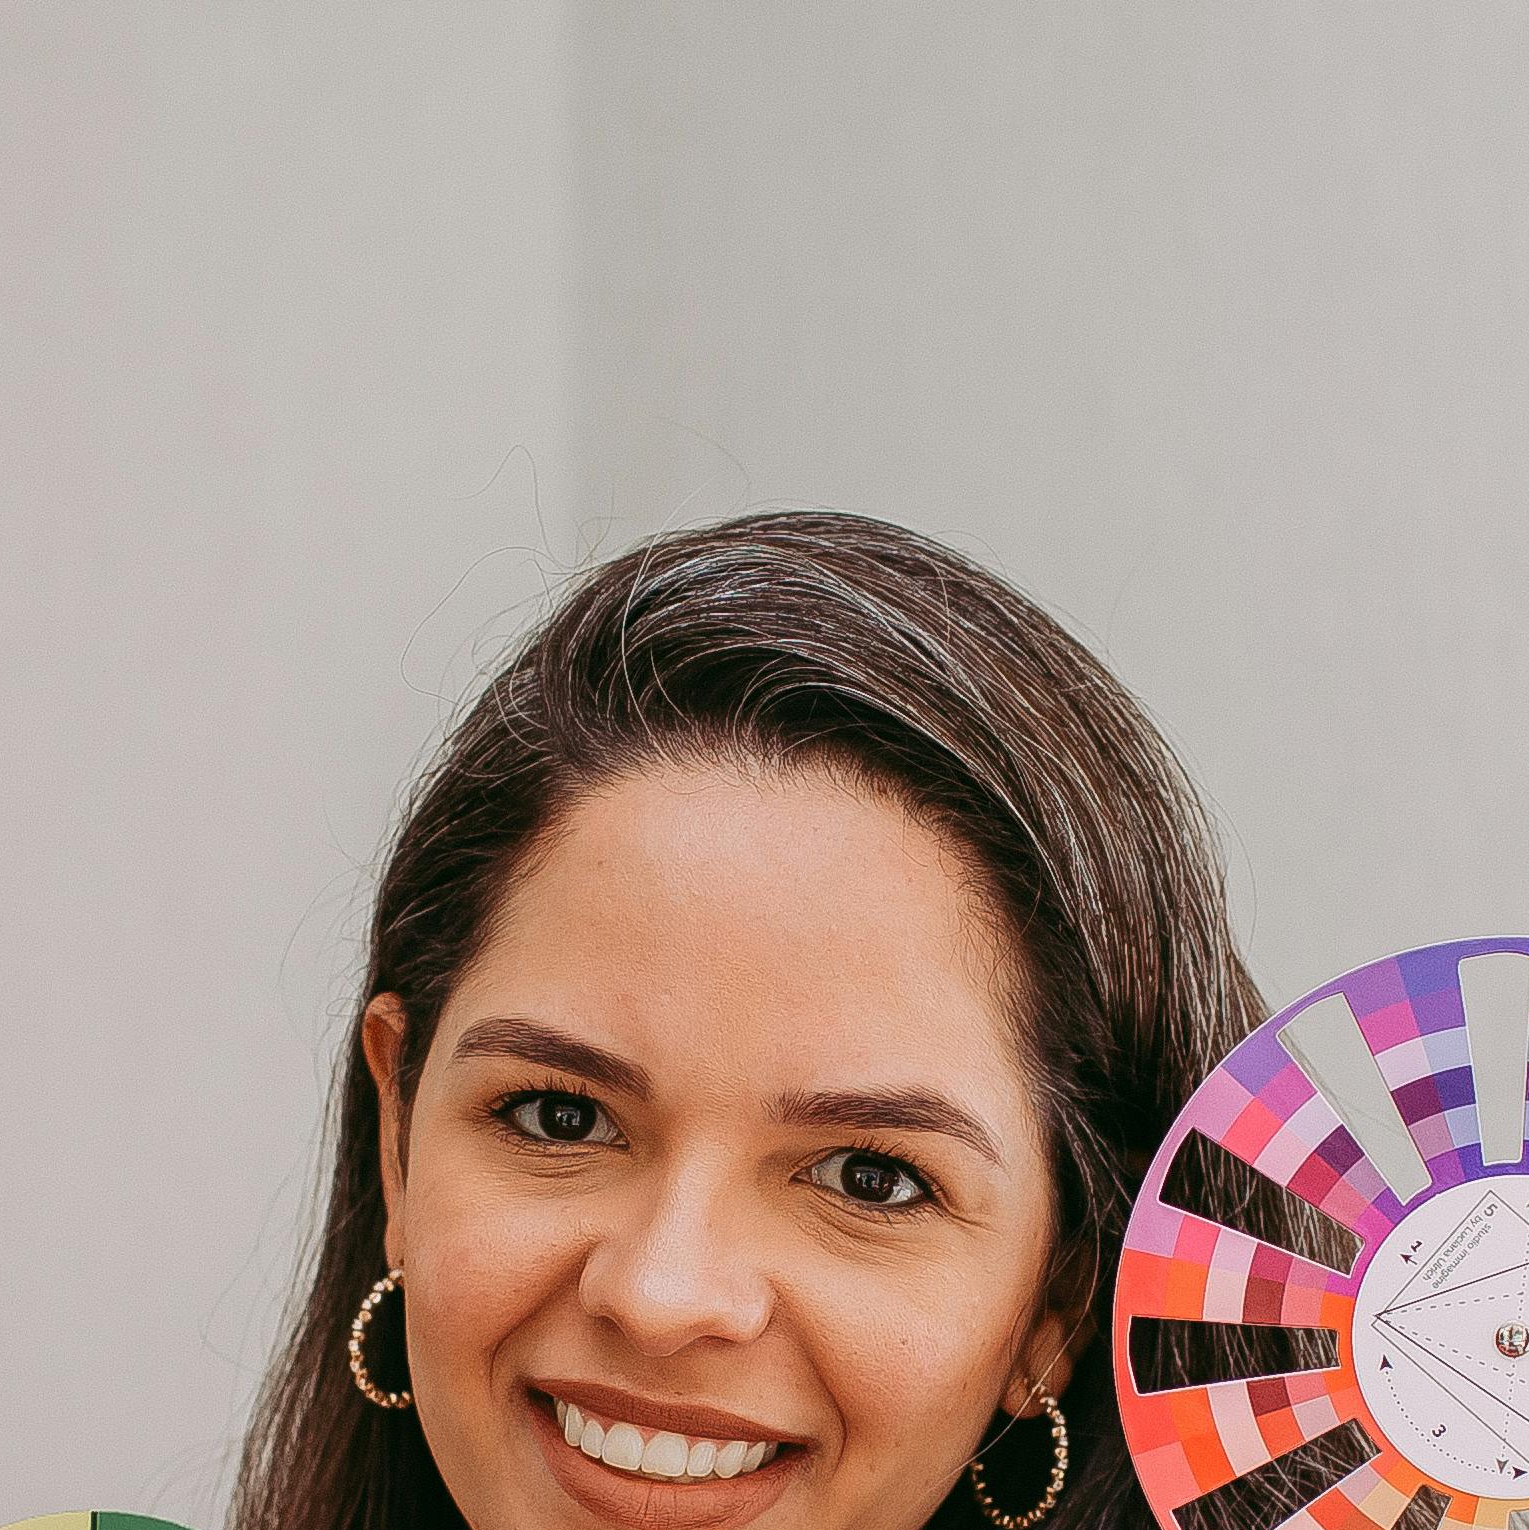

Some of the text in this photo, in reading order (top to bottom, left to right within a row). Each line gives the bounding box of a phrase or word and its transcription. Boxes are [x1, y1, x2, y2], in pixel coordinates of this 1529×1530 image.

[1483, 1203, 1498, 1217] 5
[1410, 1240, 1423, 1253] 1
[1422, 1214, 1483, 1281] by Luciana Ulrich
[1432, 1223, 1492, 1289] studio immagine
[1432, 1424, 1447, 1438] 3
